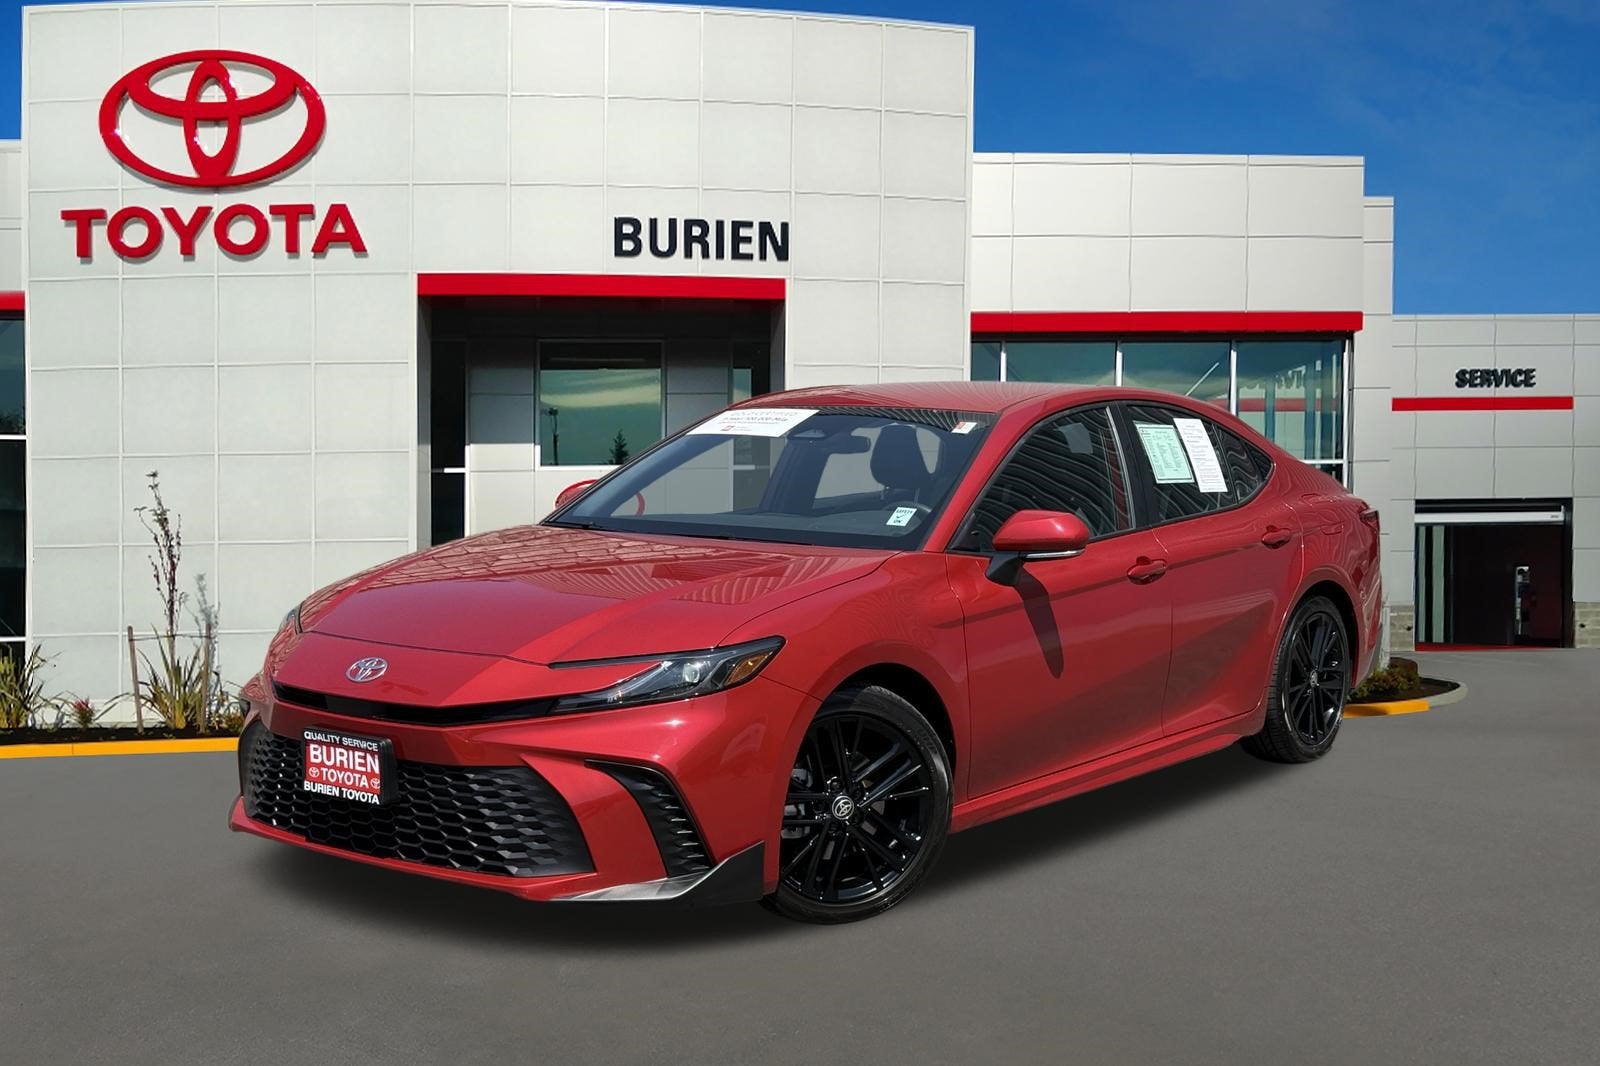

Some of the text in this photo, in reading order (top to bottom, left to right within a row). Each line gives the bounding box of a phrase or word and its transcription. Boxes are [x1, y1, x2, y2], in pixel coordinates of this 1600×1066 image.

[61, 203, 368, 260] TOYOTA
[614, 217, 789, 261] BURIEN
[1455, 368, 1536, 388] SERVICE
[304, 731, 379, 751] QUALITY SERVICE
[309, 743, 380, 774] BURIEN
[321, 768, 369, 788] TOYOTA
[304, 780, 379, 804] BURIEN TOYOTA
